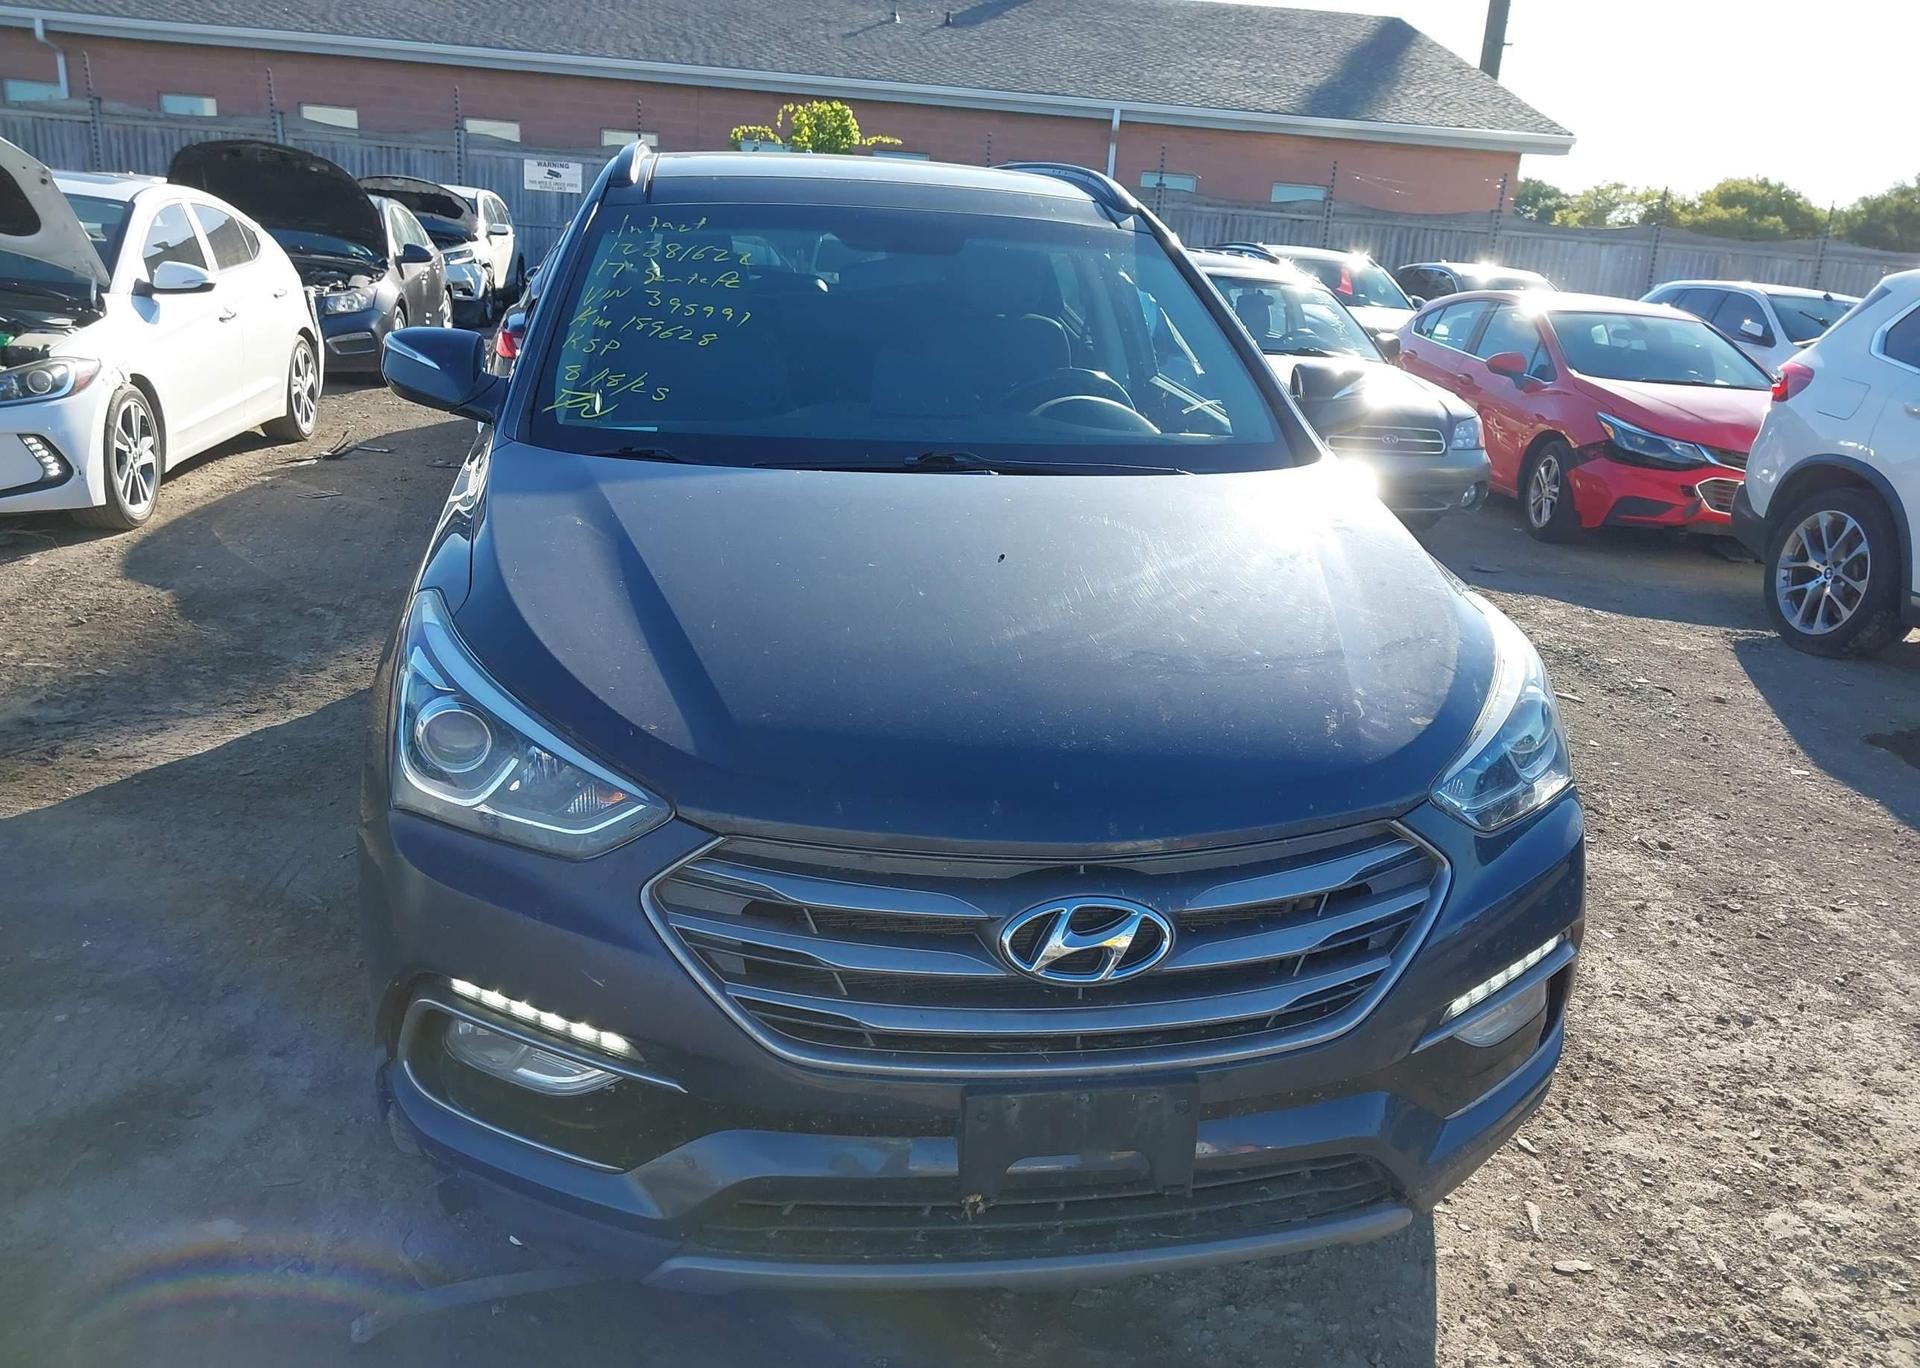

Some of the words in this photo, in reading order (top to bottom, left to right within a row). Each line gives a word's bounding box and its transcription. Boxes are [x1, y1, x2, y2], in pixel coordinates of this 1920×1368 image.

[536, 161, 570, 169] WARNING
[583, 286, 633, 305] VIN
[620, 316, 719, 347] 189628
